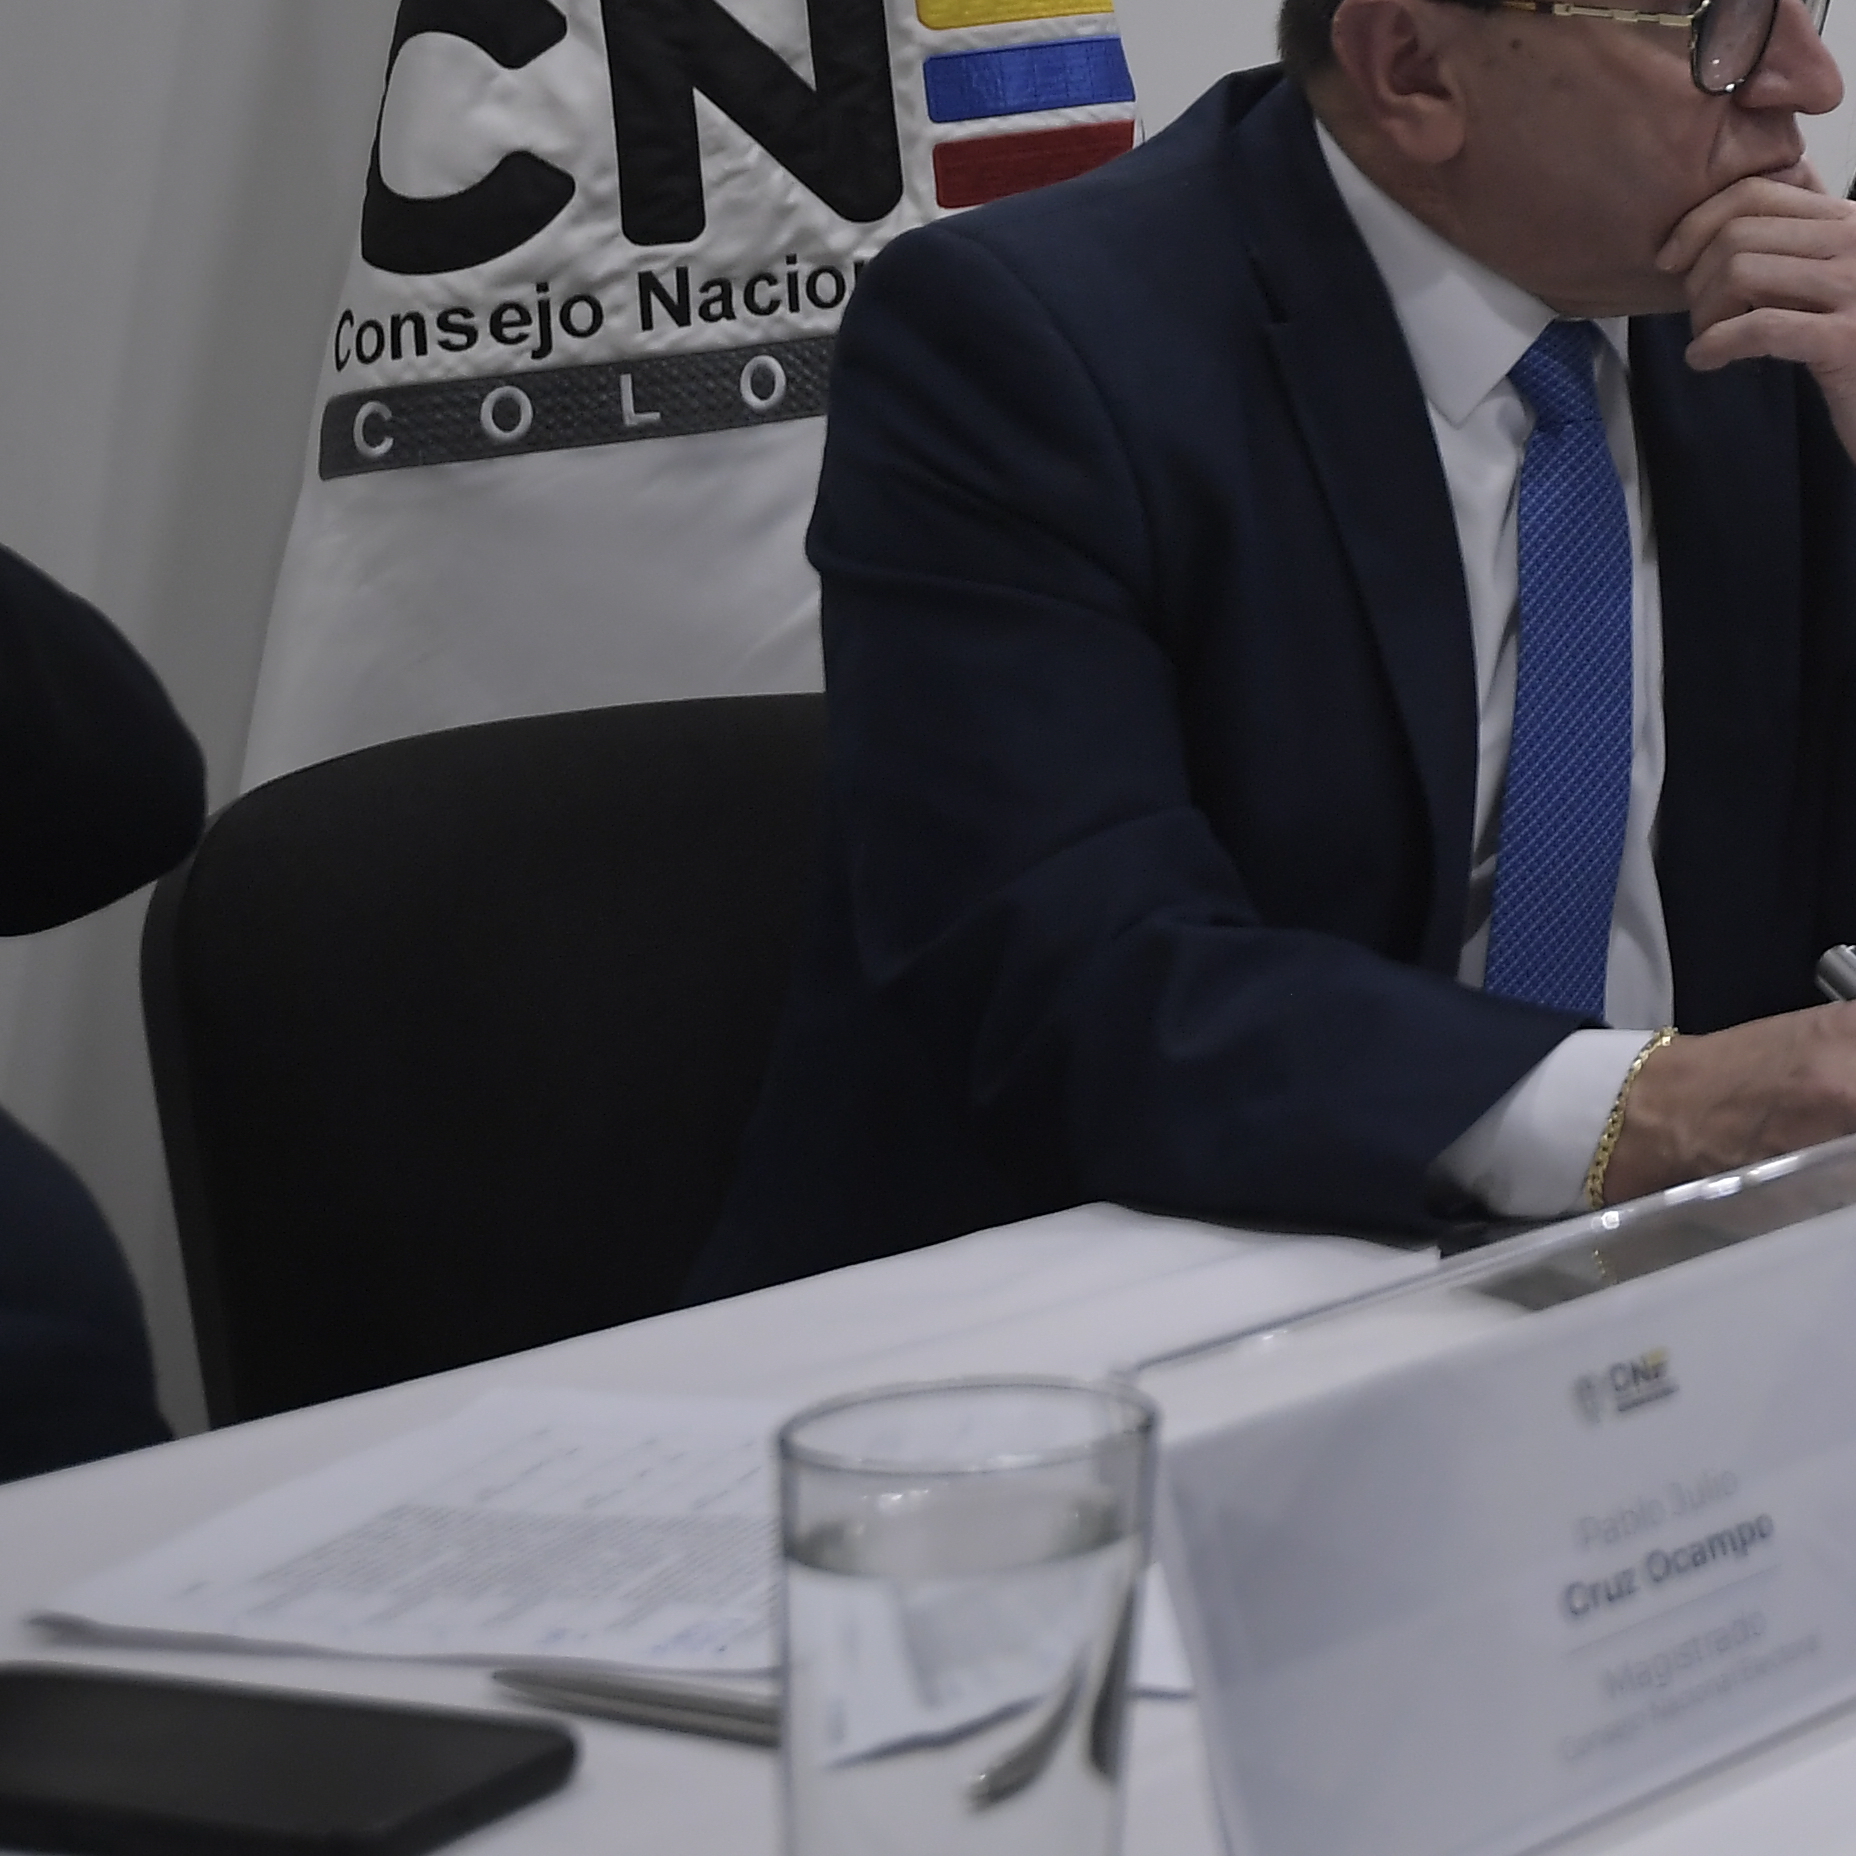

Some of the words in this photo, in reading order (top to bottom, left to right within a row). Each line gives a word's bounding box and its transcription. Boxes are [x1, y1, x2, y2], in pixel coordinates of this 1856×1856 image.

[333, 283, 604, 374] Consejo
[637, 253, 866, 334] Nacio
[1562, 1566, 1640, 1618] Cruz
[1645, 1512, 1775, 1583] Ocampo
